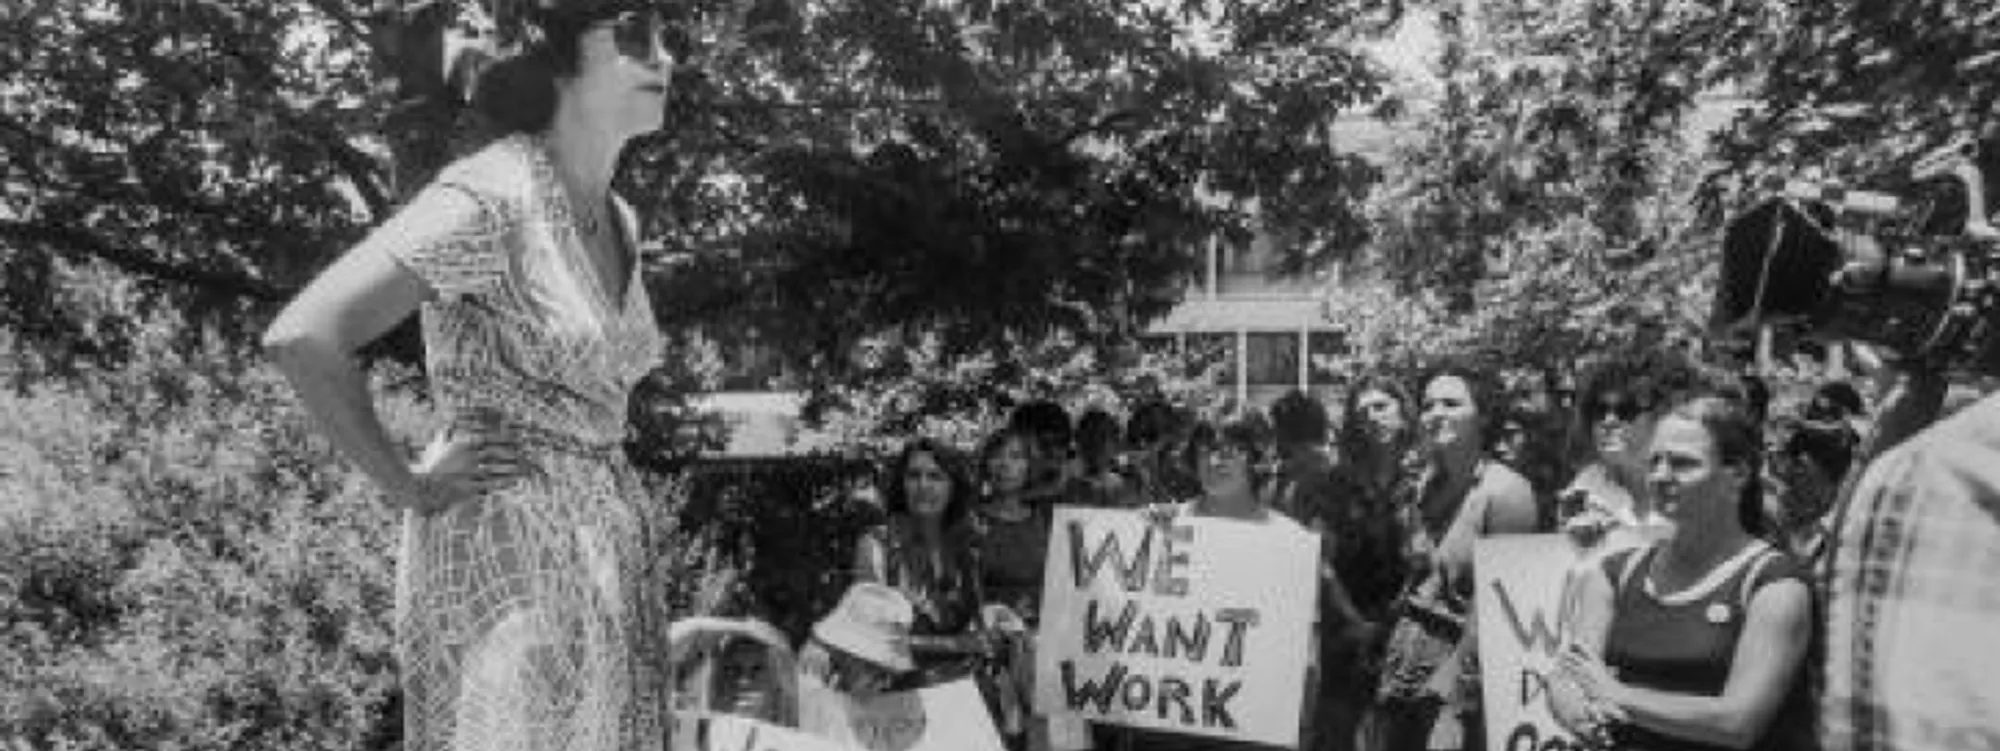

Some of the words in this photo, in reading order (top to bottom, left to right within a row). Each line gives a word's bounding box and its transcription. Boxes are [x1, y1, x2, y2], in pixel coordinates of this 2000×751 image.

[1067, 514, 1195, 597] WE
[1083, 599, 1260, 668] WANT
[1490, 570, 1573, 659] W
[1060, 659, 1242, 729] WORK
